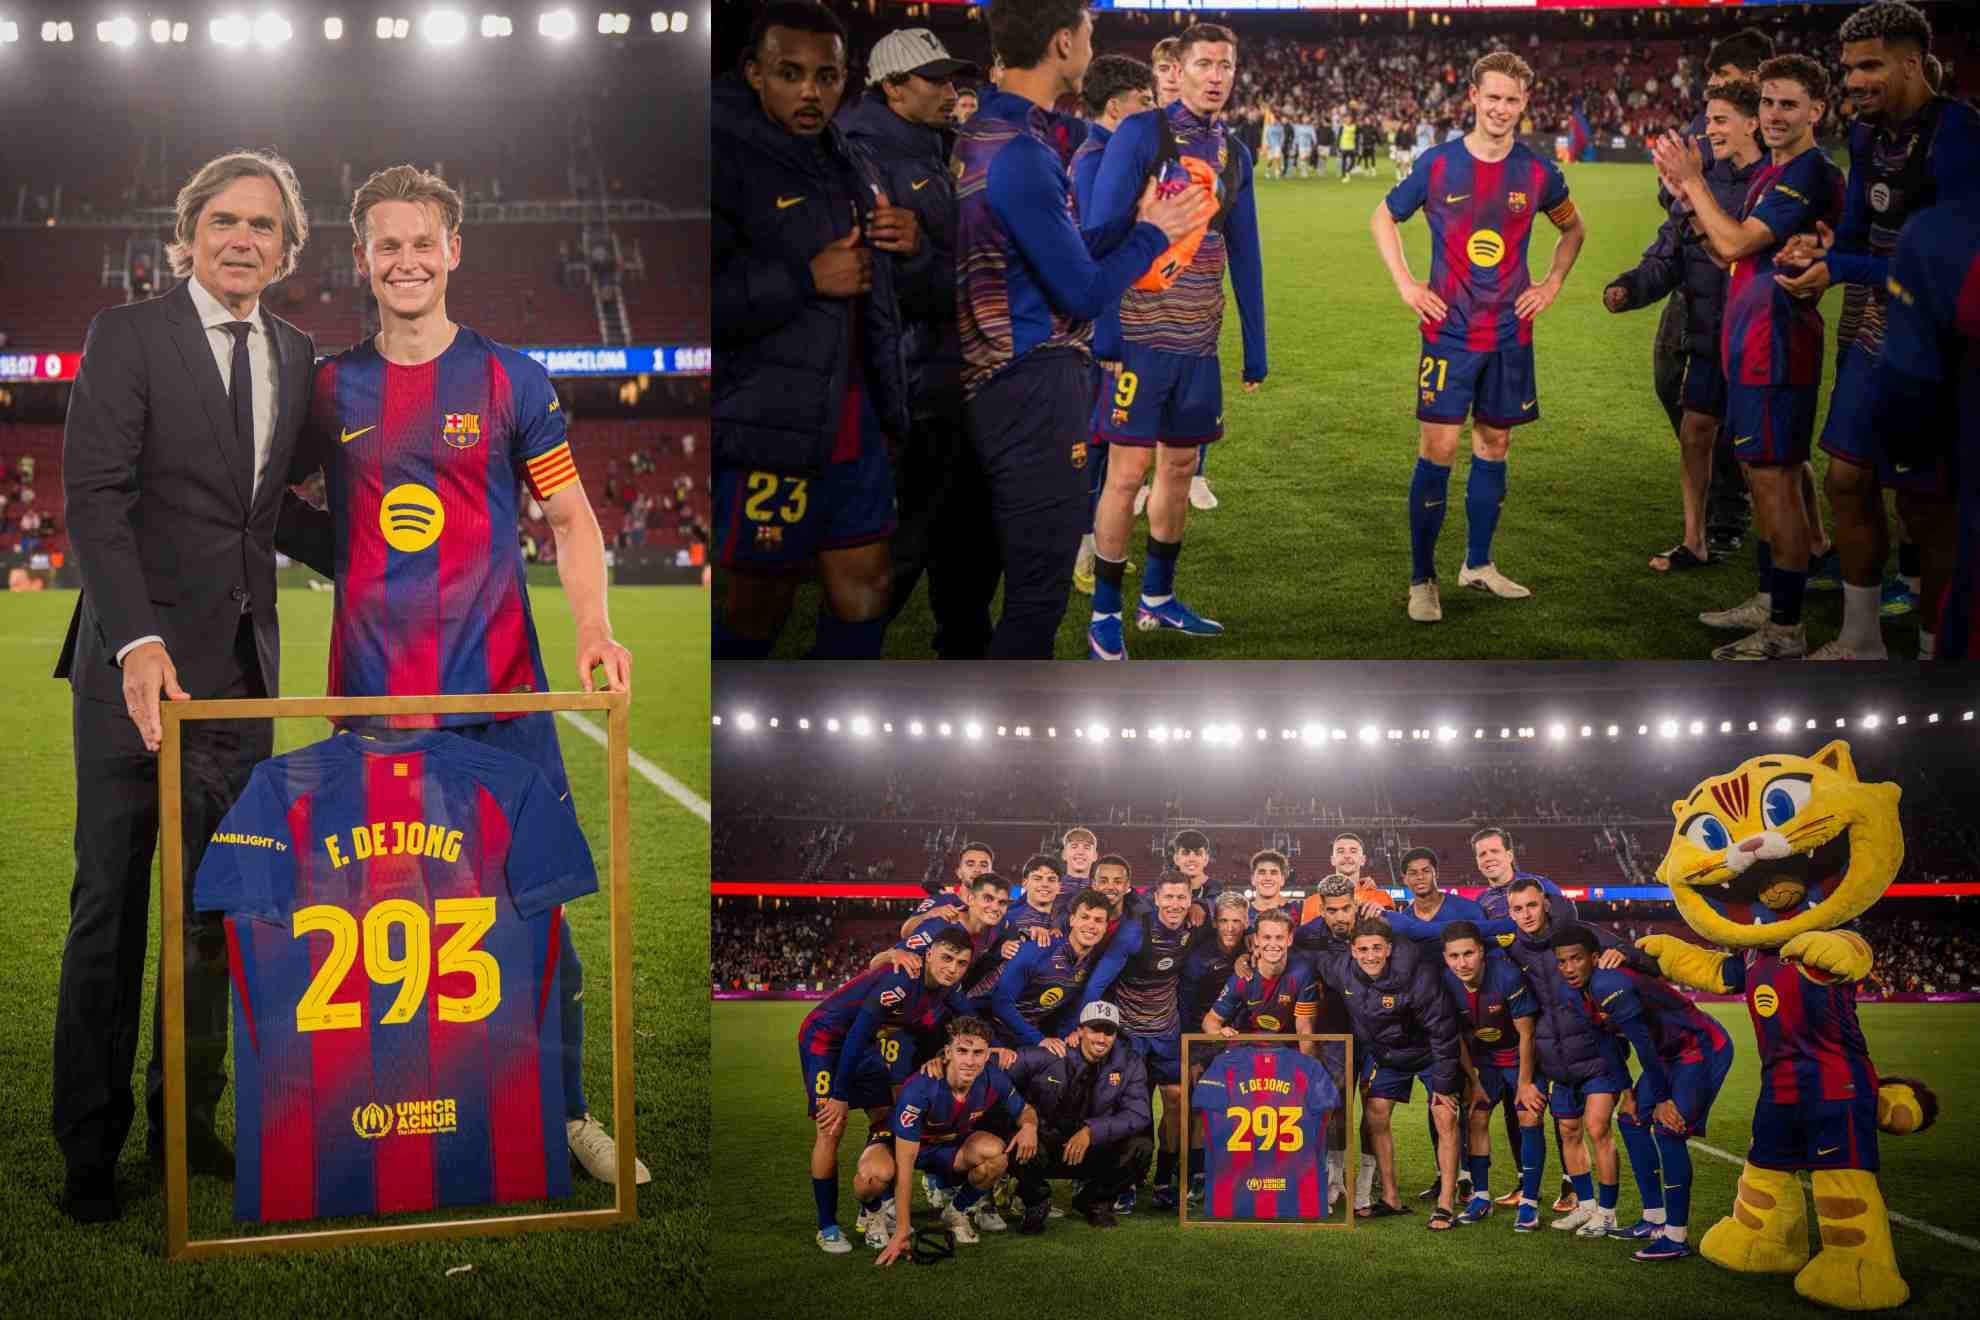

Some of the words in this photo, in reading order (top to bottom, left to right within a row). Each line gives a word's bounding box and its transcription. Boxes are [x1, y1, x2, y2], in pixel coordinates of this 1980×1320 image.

[45, 353, 61, 378] 0
[547, 350, 627, 371] BARCELONA
[653, 349, 664, 371] 1
[1420, 356, 1448, 391] 21
[1115, 371, 1138, 407] 9
[745, 471, 807, 523] 23
[210, 832, 274, 849] AMBILIGHT
[324, 835, 350, 870] F.
[352, 822, 388, 860] DE
[389, 821, 464, 863] JONG
[292, 897, 501, 1033] 293
[880, 1038, 900, 1062] 18
[815, 1070, 831, 1095] 8
[1250, 1079, 1264, 1091] DE
[1265, 1078, 1291, 1095] JONG
[396, 1098, 456, 1116] UNHCR
[396, 1112, 456, 1130] ACNUR
[1226, 1105, 1304, 1152] 293
